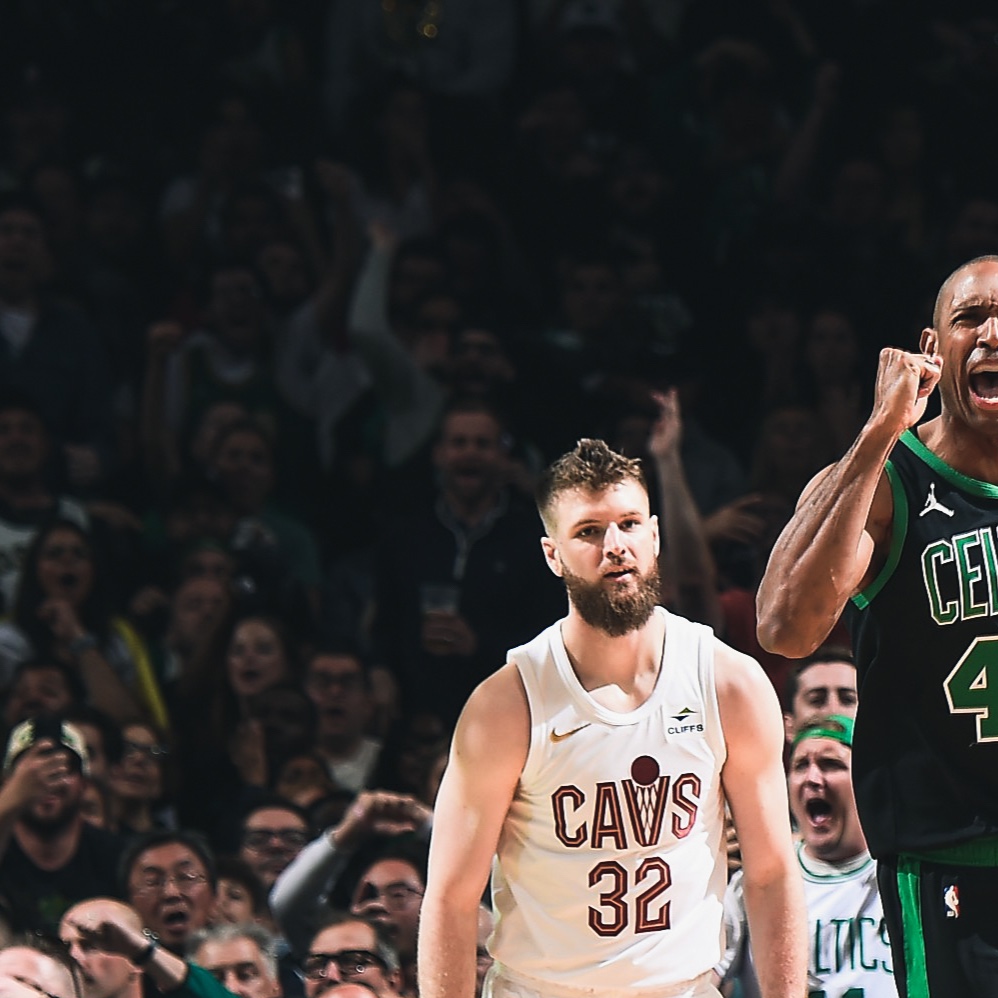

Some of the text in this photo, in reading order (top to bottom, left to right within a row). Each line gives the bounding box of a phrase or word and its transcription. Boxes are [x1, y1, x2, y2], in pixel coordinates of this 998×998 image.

[667, 723, 704, 735] CLIFFS
[551, 772, 701, 850] CAVS
[588, 856, 672, 937] 32
[815, 917, 894, 974] LTICS
